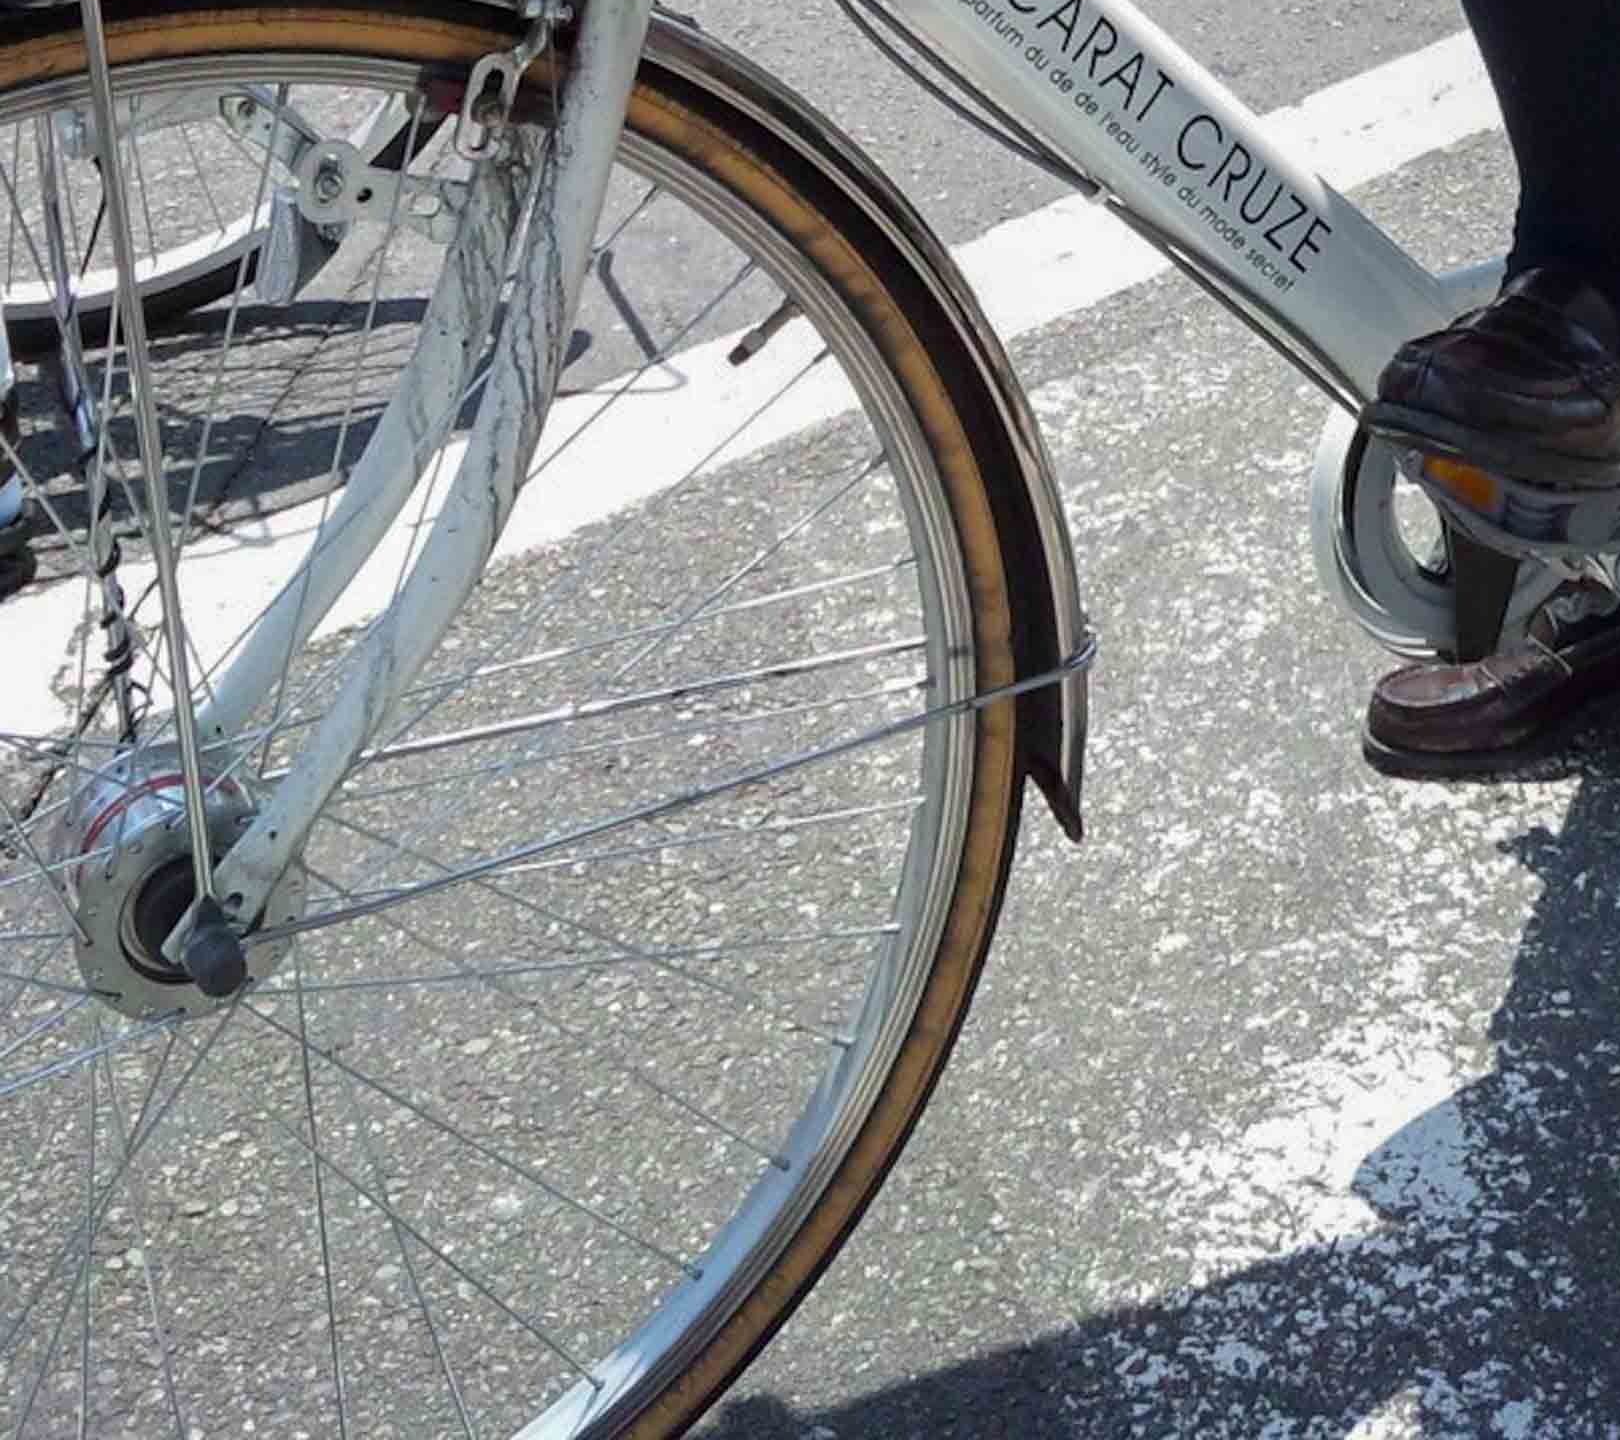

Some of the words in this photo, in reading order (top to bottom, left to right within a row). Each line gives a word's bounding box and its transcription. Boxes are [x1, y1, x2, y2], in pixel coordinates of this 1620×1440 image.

[1024, 46, 1050, 71] du
[1049, 69, 1075, 94] de
[1074, 92, 1099, 116] de
[1177, 185, 1201, 210] du
[1200, 205, 1246, 250] mode
[1177, 114, 1333, 274] CRUZE
